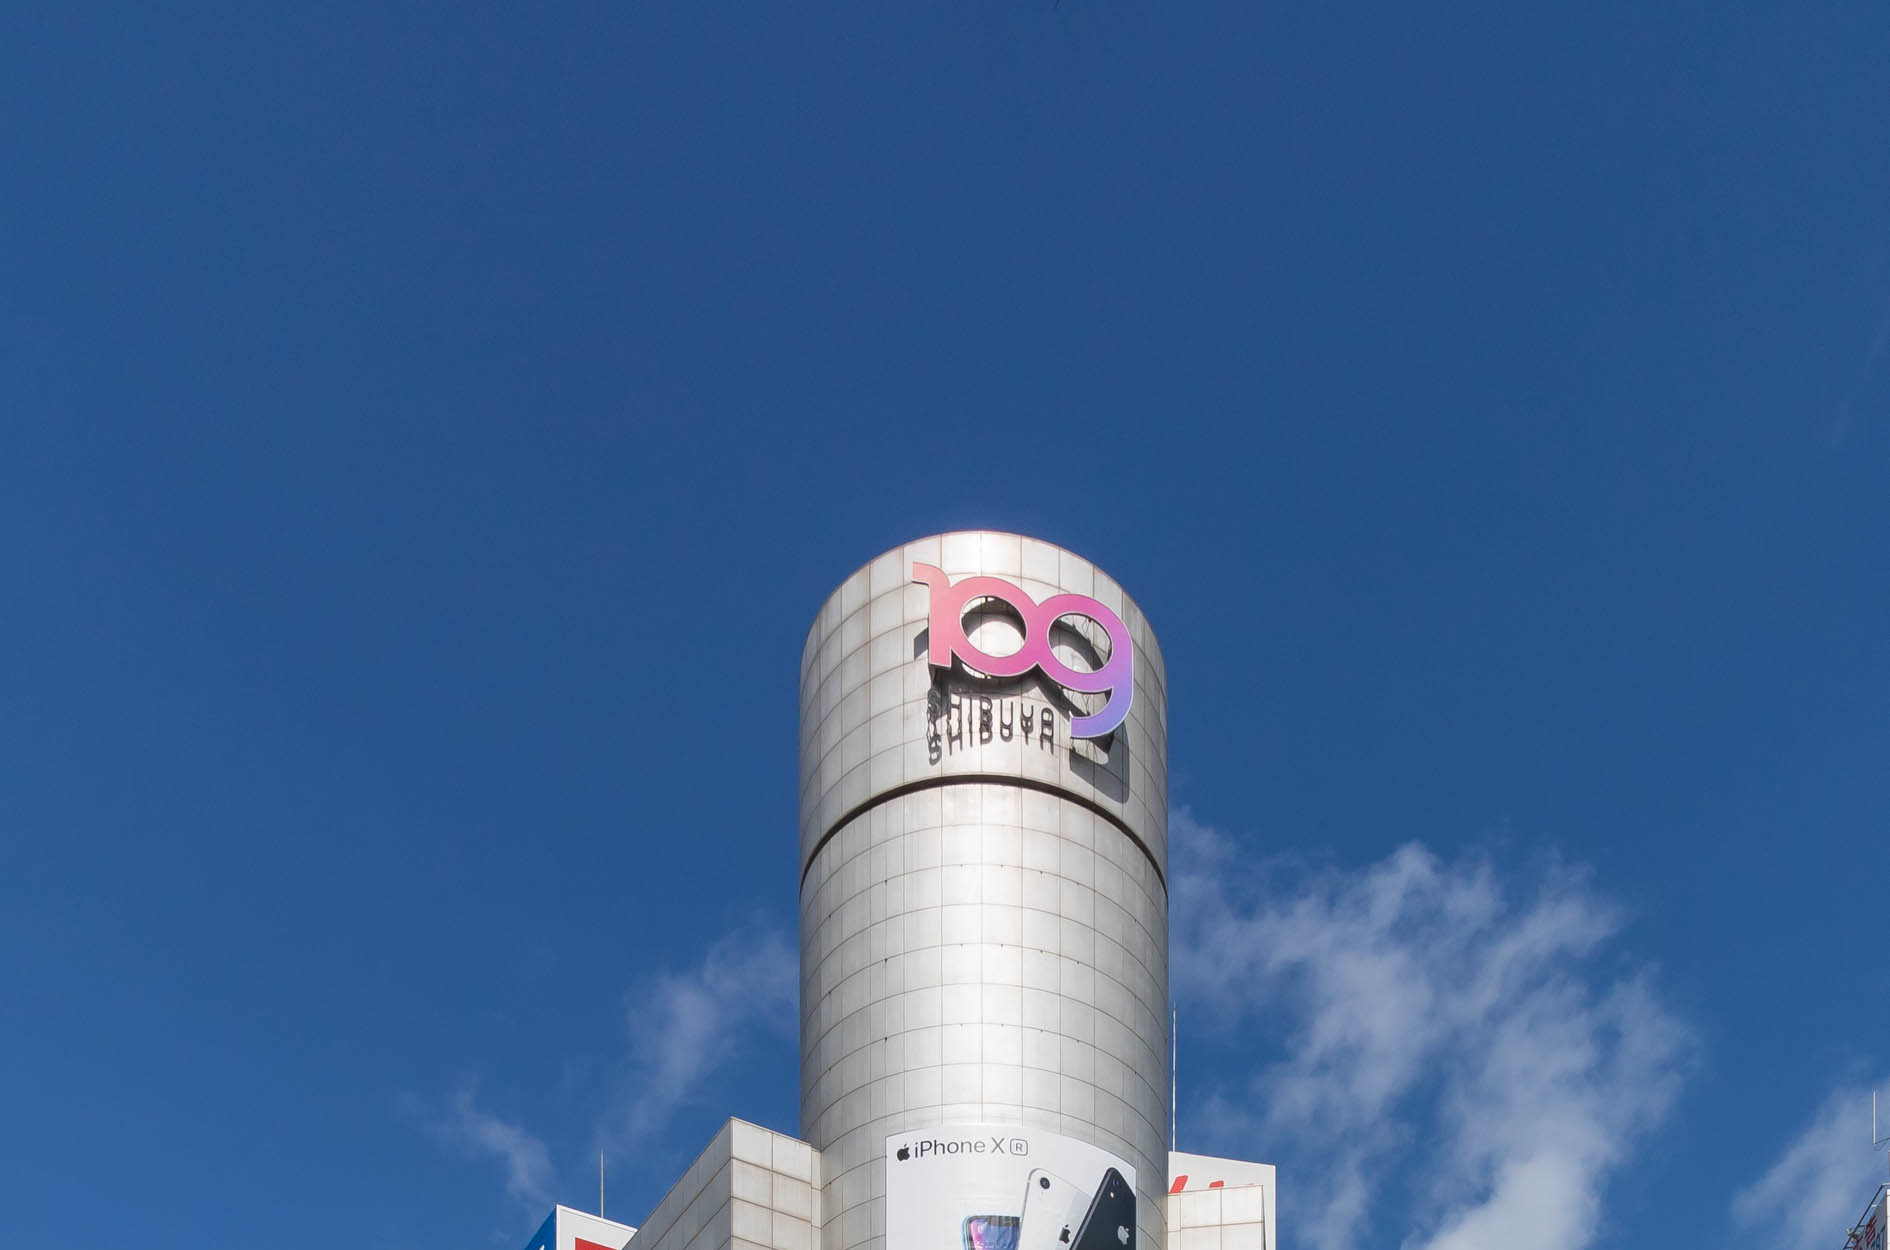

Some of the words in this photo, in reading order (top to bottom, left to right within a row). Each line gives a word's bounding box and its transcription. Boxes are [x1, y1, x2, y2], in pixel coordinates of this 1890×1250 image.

[912, 561, 1133, 737] 109
[926, 688, 1054, 752] SHIBUYA
[914, 1139, 986, 1159] iPhone
